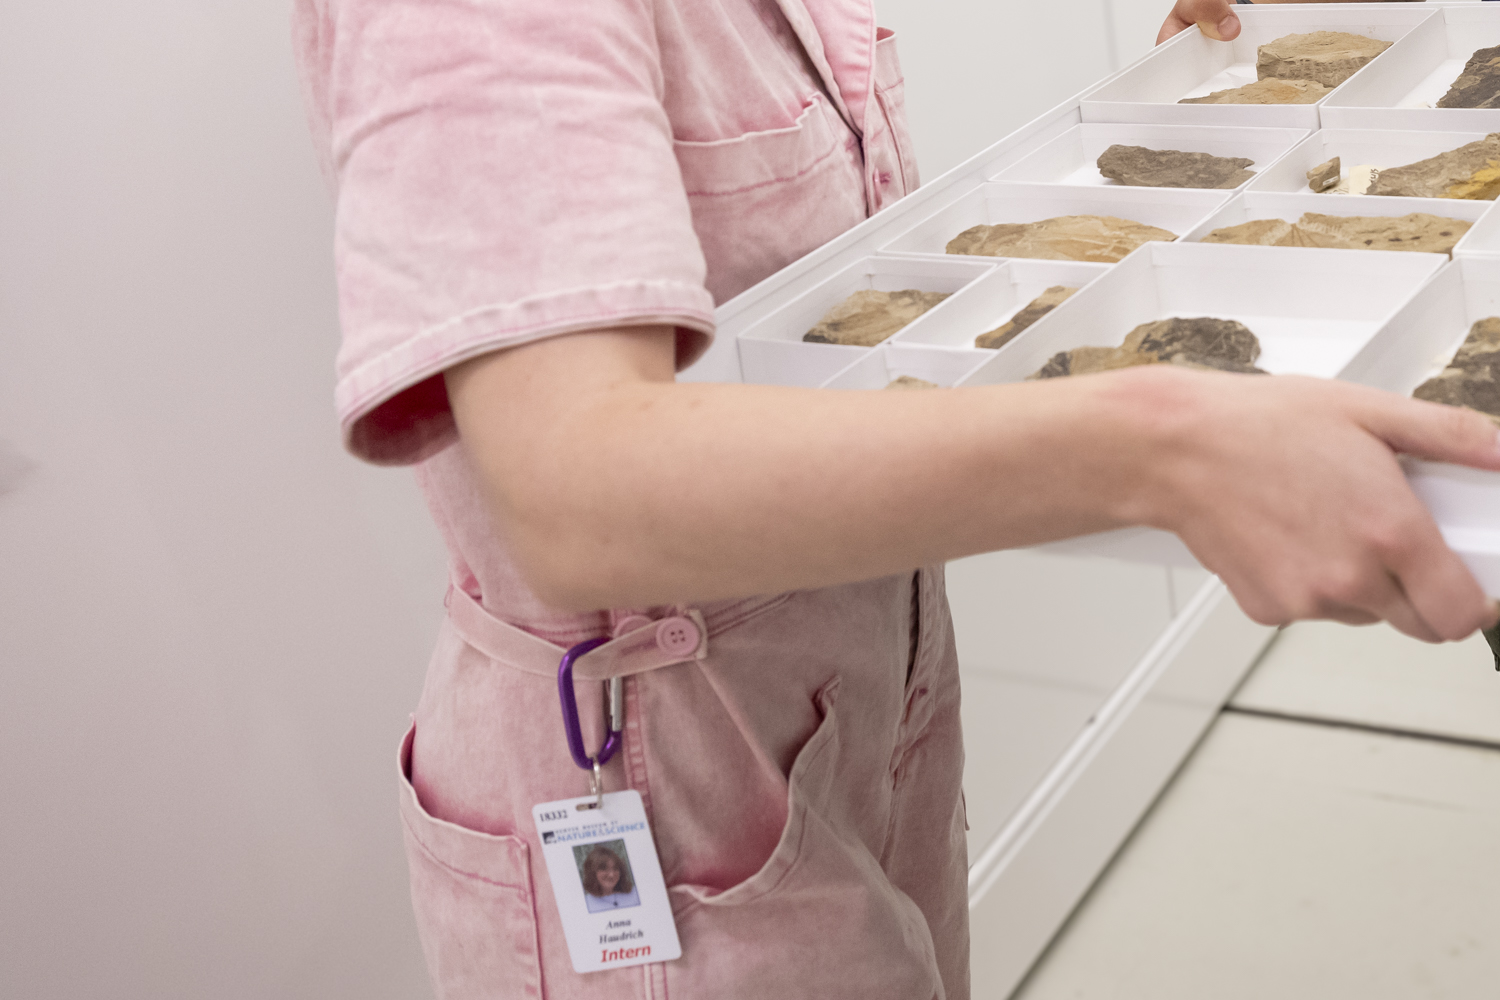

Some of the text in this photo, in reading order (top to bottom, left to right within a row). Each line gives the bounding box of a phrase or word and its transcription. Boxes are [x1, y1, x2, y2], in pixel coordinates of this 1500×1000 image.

[539, 809, 568, 822] 18332
[606, 919, 632, 930] Anna
[601, 945, 651, 963] Intern
